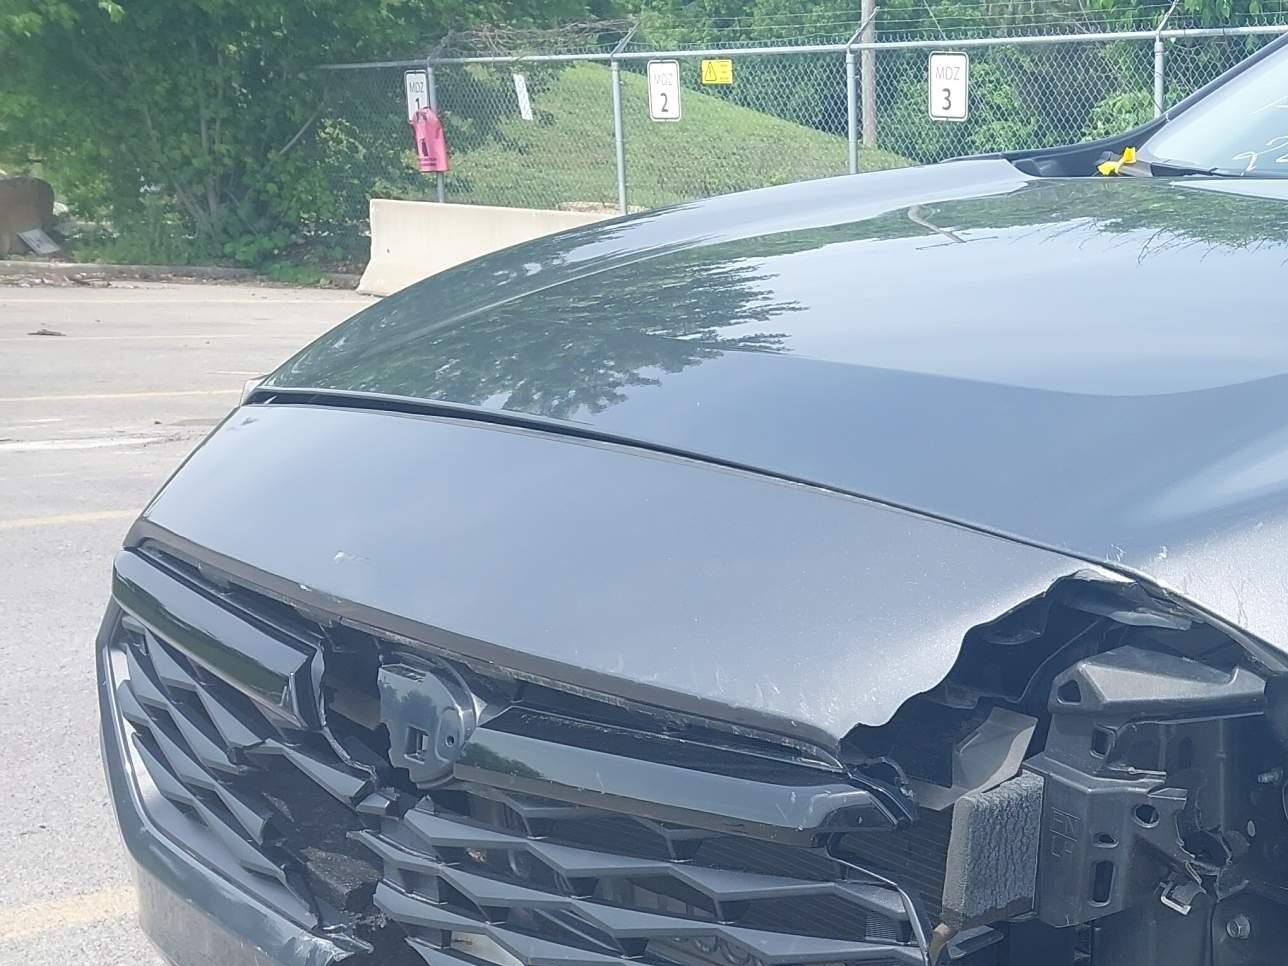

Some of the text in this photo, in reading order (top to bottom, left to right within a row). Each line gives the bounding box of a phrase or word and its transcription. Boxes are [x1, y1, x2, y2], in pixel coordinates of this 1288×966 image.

[935, 66, 960, 80] MDZ
[409, 82, 424, 93] MDZ
[660, 92, 669, 112] 2
[942, 87, 951, 110] 3
